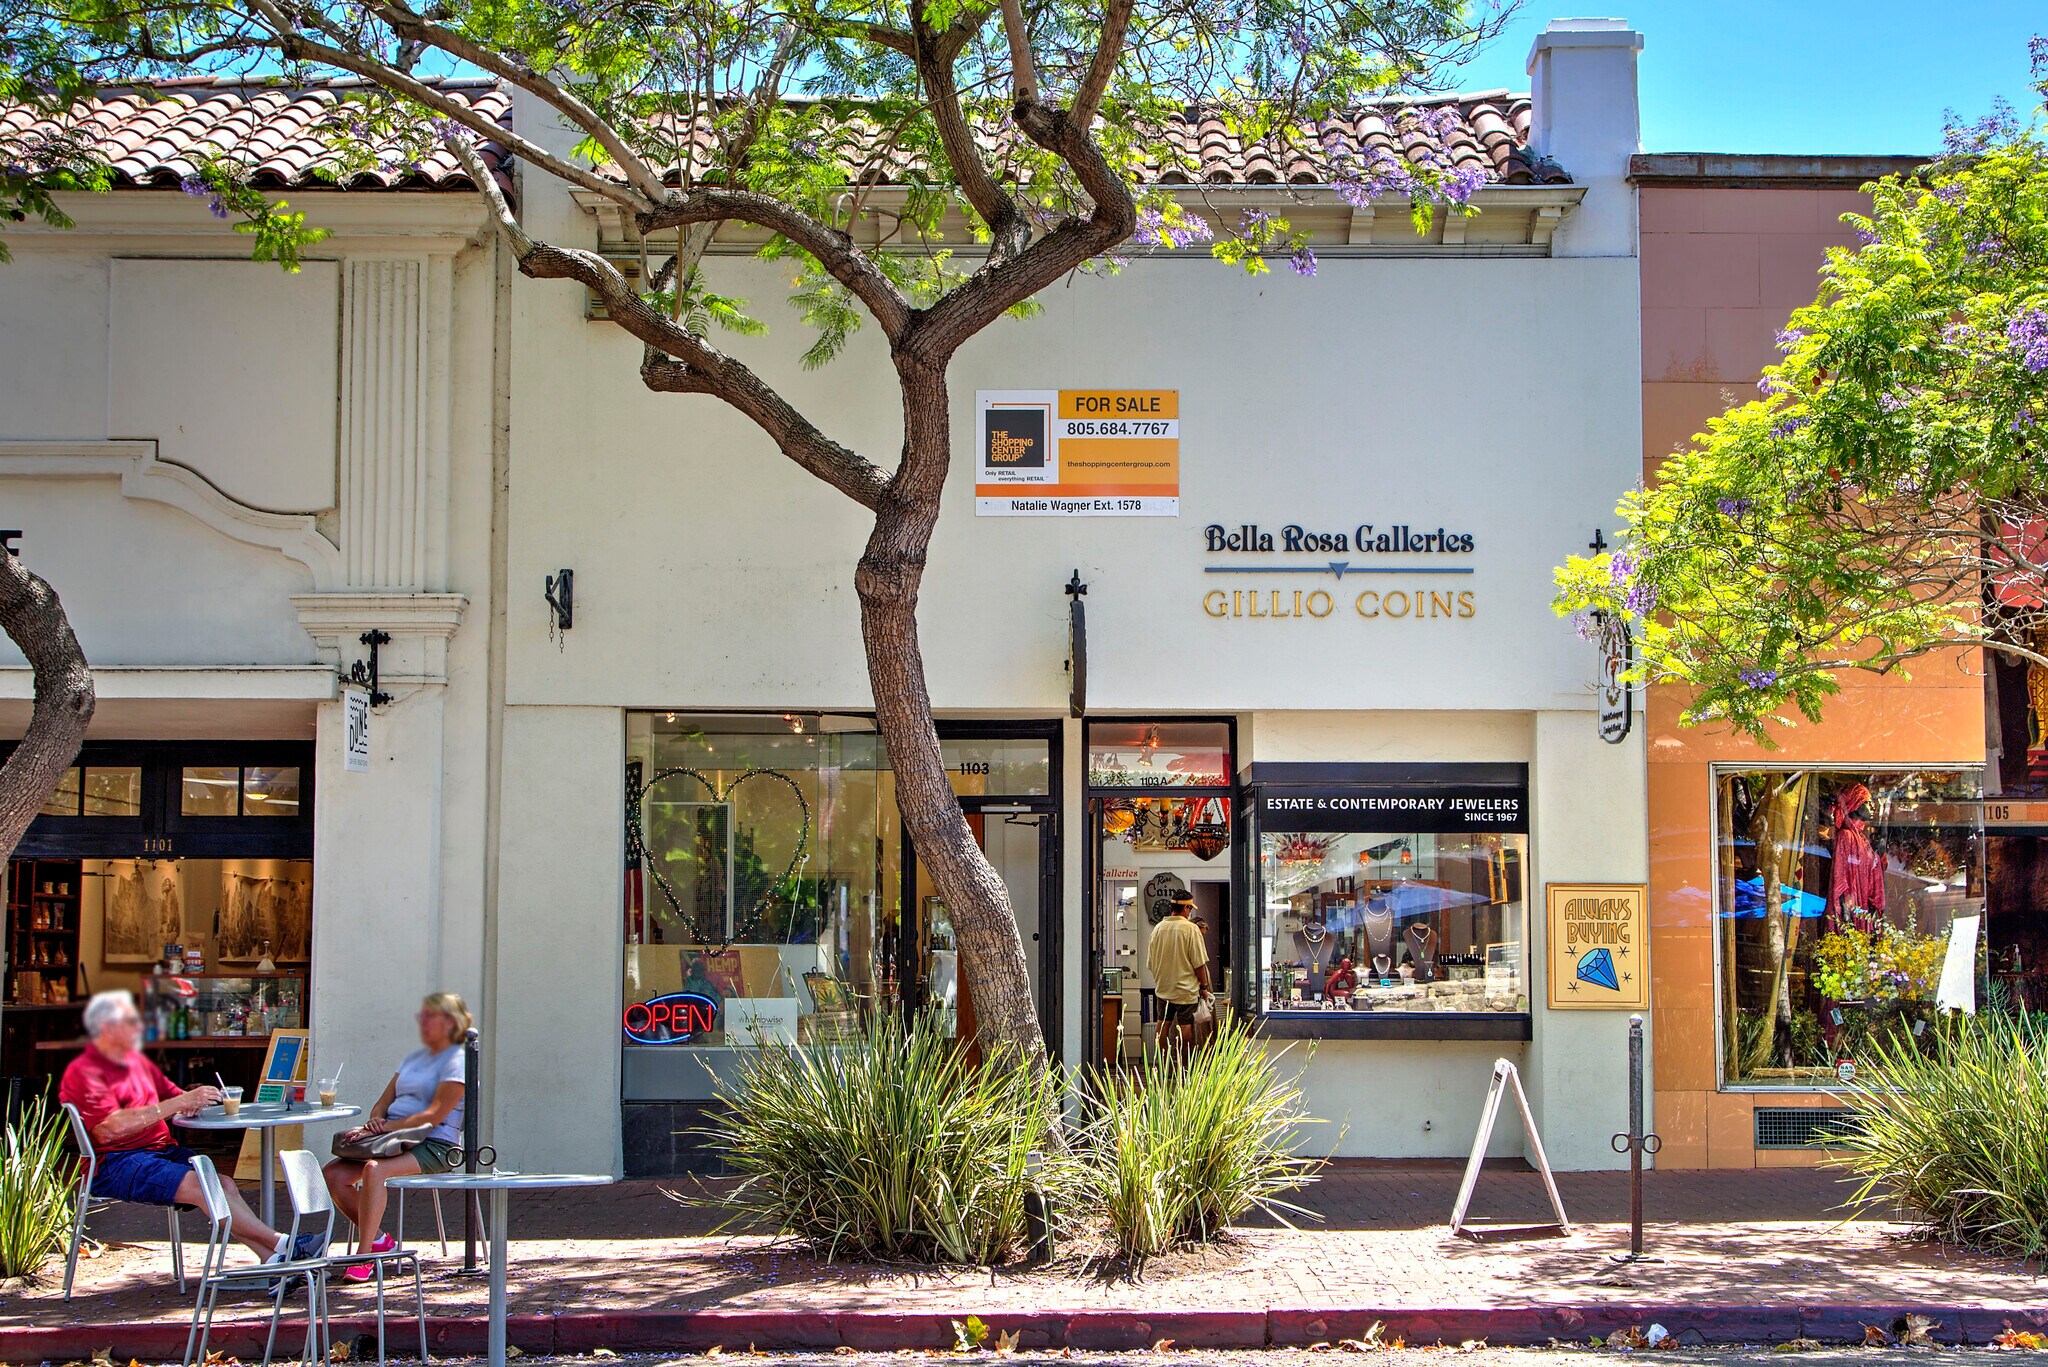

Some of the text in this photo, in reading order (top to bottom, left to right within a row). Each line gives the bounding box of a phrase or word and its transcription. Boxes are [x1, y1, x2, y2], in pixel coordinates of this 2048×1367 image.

[1075, 397, 1161, 412] FOR SALE
[991, 430, 1009, 439] THE
[1067, 422, 1170, 436] 805.684.7767
[991, 438, 1034, 447] SHOPPING
[991, 446, 1026, 455] CENTER
[1067, 460, 1171, 469] theshoppingcentergroup.com
[1011, 500, 1048, 511] Natalie
[1050, 500, 1091, 513] Wagner
[1094, 500, 1114, 511] Ext.
[1117, 500, 1142, 511] 1578
[1204, 524, 1475, 553] Bella Rosa Galleries
[1203, 589, 1476, 618] GILLIO COINS
[960, 762, 989, 775] 1103
[1140, 776, 1159, 786] 1103
[1267, 798, 1519, 811] ESTATE & CONTEMPORARY JEWELERS
[1464, 813, 1518, 822] SINCE 1967
[144, 838, 172, 852] 1101
[1146, 882, 1177, 898] Coin
[1564, 898, 1632, 921] ALWAYS
[1566, 922, 1631, 944] BUYING
[706, 958, 738, 973] HEMP
[624, 1003, 714, 1033] OPEN
